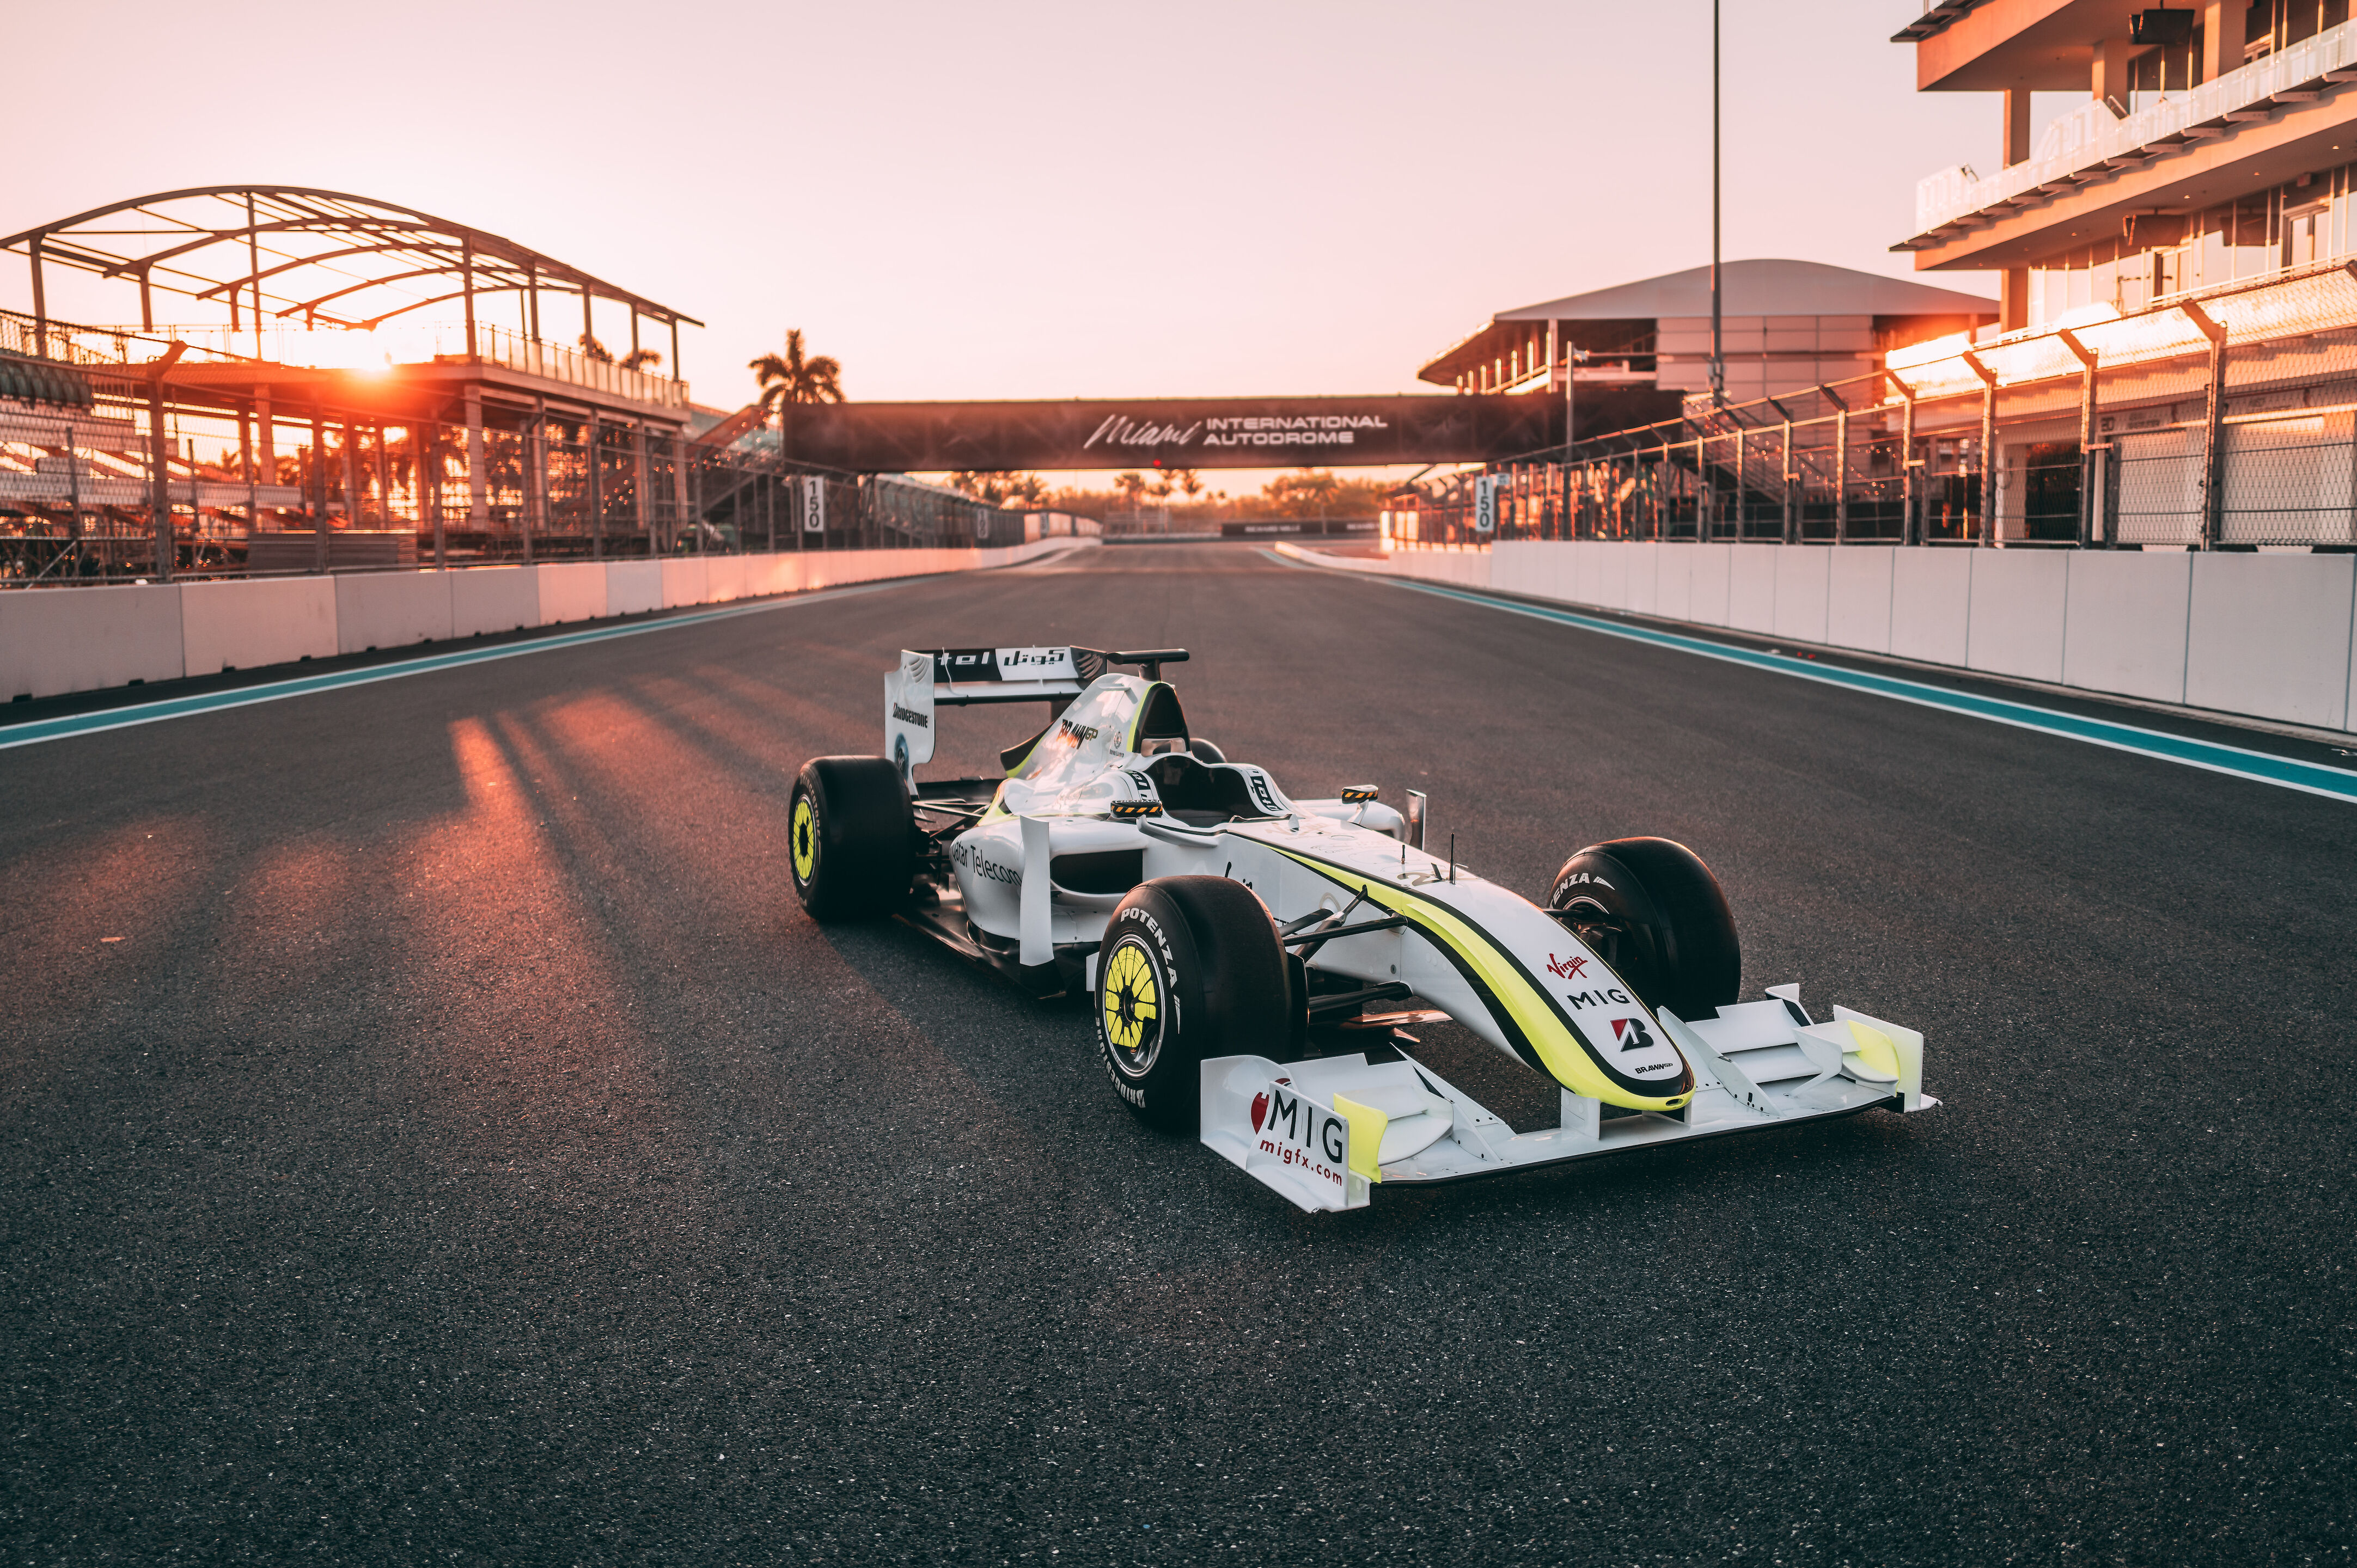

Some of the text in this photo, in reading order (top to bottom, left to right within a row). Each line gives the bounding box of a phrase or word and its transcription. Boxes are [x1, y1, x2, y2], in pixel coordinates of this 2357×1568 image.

[1083, 414, 1388, 449] Miami INTERNATIONAL
[1203, 431, 1354, 445] AUTODROME
[809, 481, 820, 528] 150
[1480, 481, 1490, 528] 150
[893, 702, 928, 728] BRIDGESTONE
[970, 844, 1022, 887] Telecom
[1120, 908, 1177, 988] POTENZA
[1547, 953, 1588, 979] Virgin
[1567, 989, 1631, 1010] MIG
[1095, 1017, 1146, 1108] BRIDGESTONE
[1267, 1089, 1342, 1163] MIG
[1260, 1140, 1342, 1186] migfx.com
